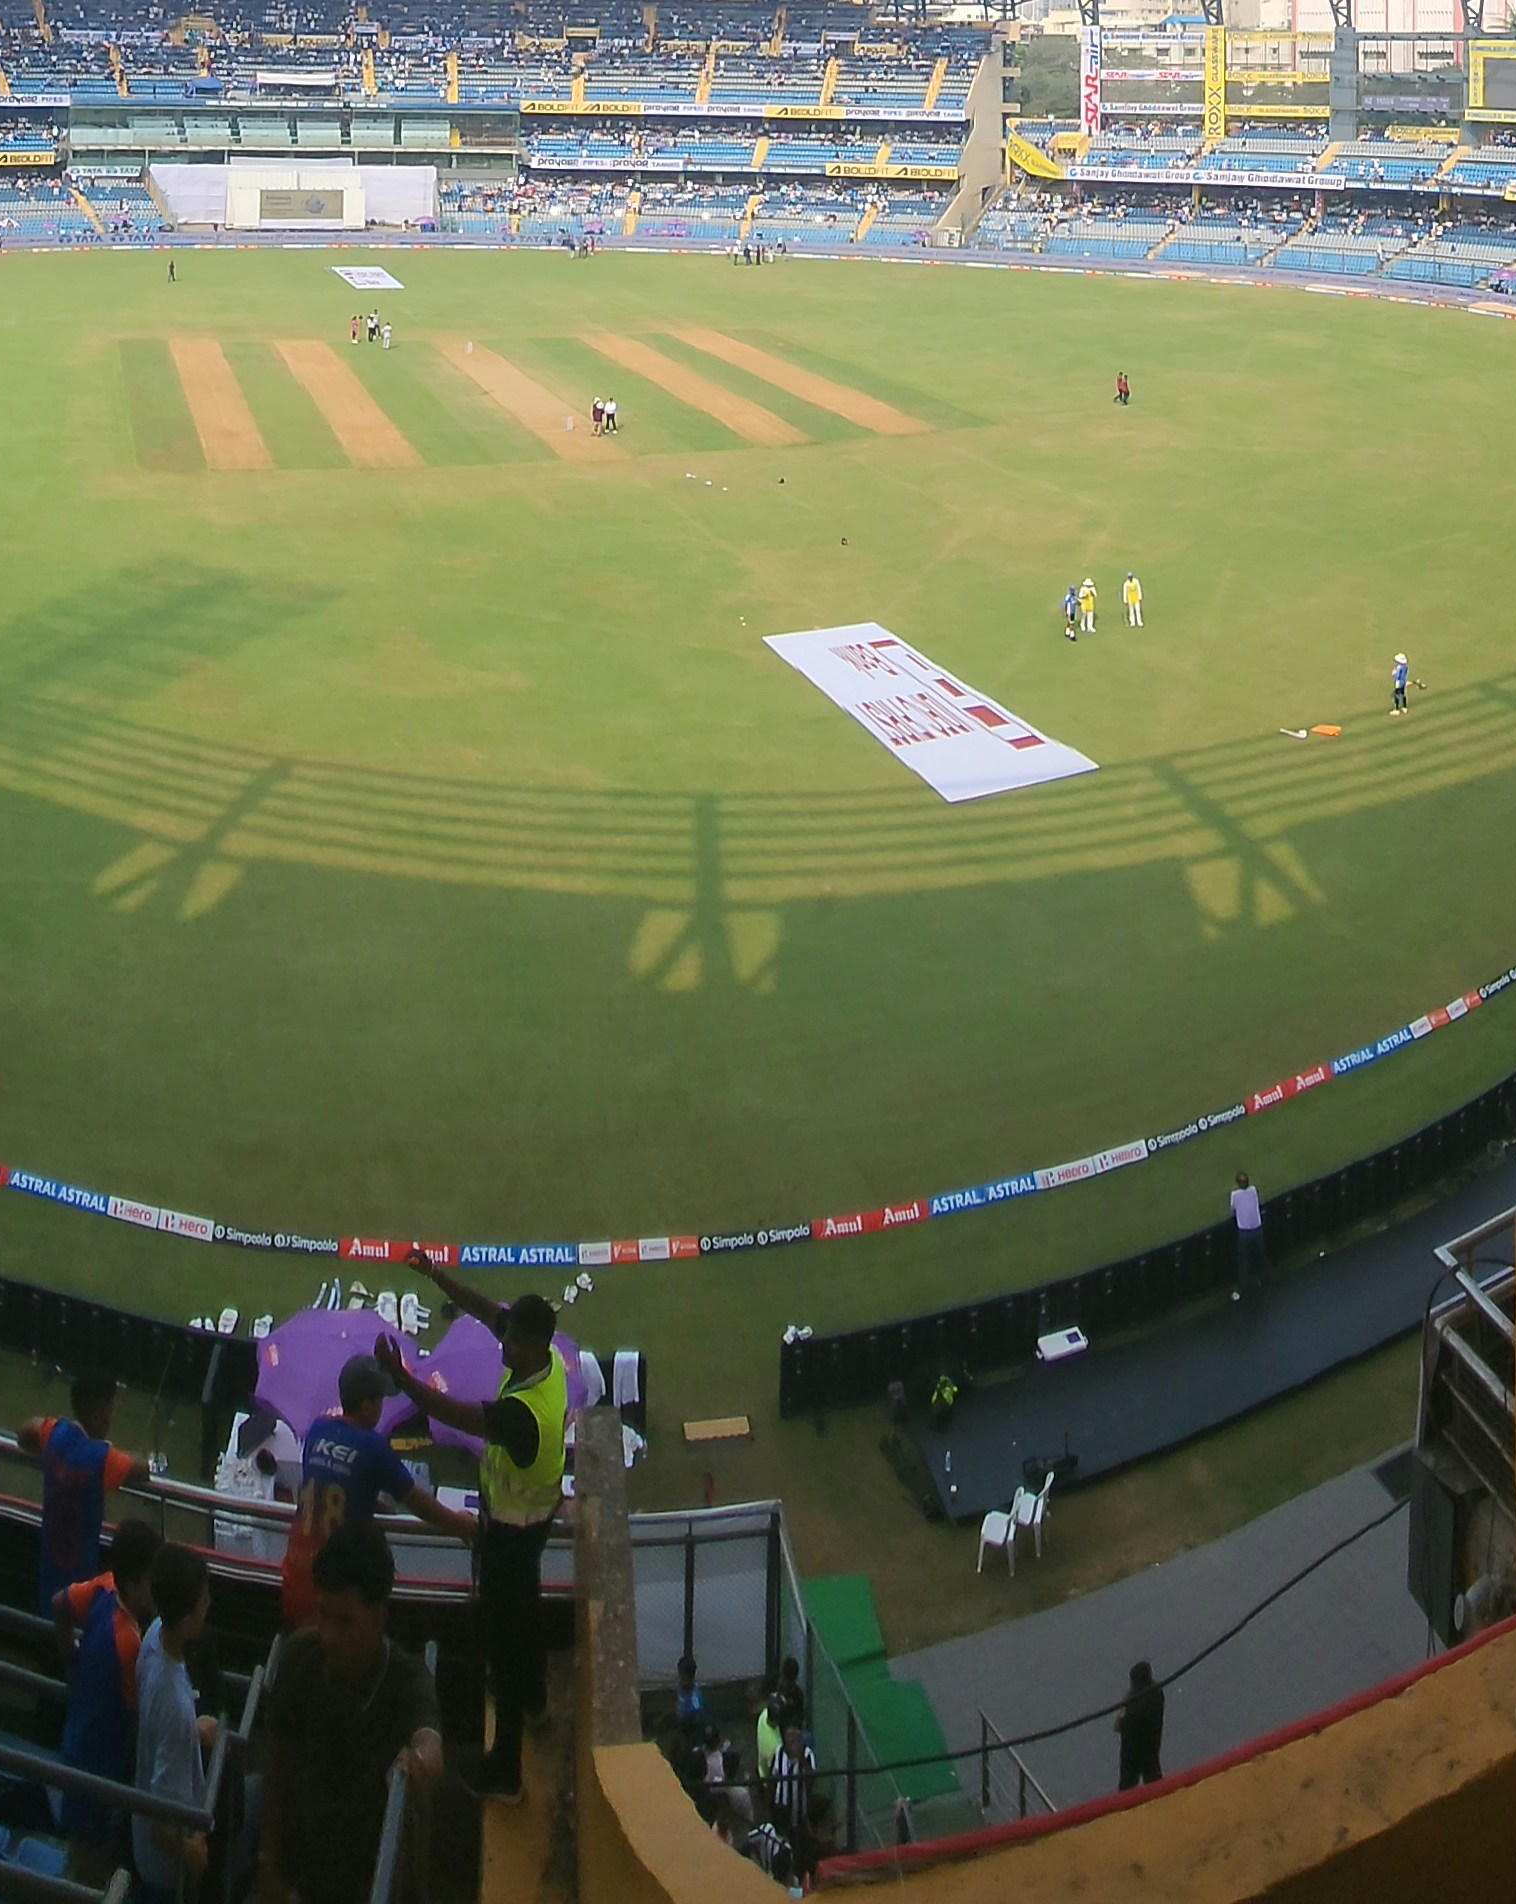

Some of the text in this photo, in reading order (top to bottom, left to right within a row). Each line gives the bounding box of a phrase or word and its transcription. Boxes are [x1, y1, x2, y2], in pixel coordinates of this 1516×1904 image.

[1209, 85, 1221, 136] ROXX
[1165, 171, 1190, 182] Group
[74, 234, 155, 244] TATA TATA
[1486, 975, 1510, 996] Simpolo
[1376, 1027, 1412, 1057] ASTRAL
[1295, 1067, 1325, 1093] Amul
[1253, 1085, 1283, 1113] Amul
[10, 1171, 56, 1198] ASTRAL
[988, 1175, 1034, 1201] ASTRAL
[58, 1186, 107, 1213] ASTRAL
[931, 1189, 979, 1215] ASTRAL
[124, 1205, 152, 1224] Hero
[881, 1201, 920, 1227] Amul
[178, 1218, 208, 1237] Hero
[768, 1224, 810, 1244] Simpolo
[824, 1215, 862, 1238] Amul
[349, 1236, 389, 1260] Amul
[712, 1232, 754, 1252] Simpolo
[461, 1245, 515, 1265] ASTRAL
[519, 1246, 573, 1266] ASTRAL
[316, 1437, 359, 1464] KEI
